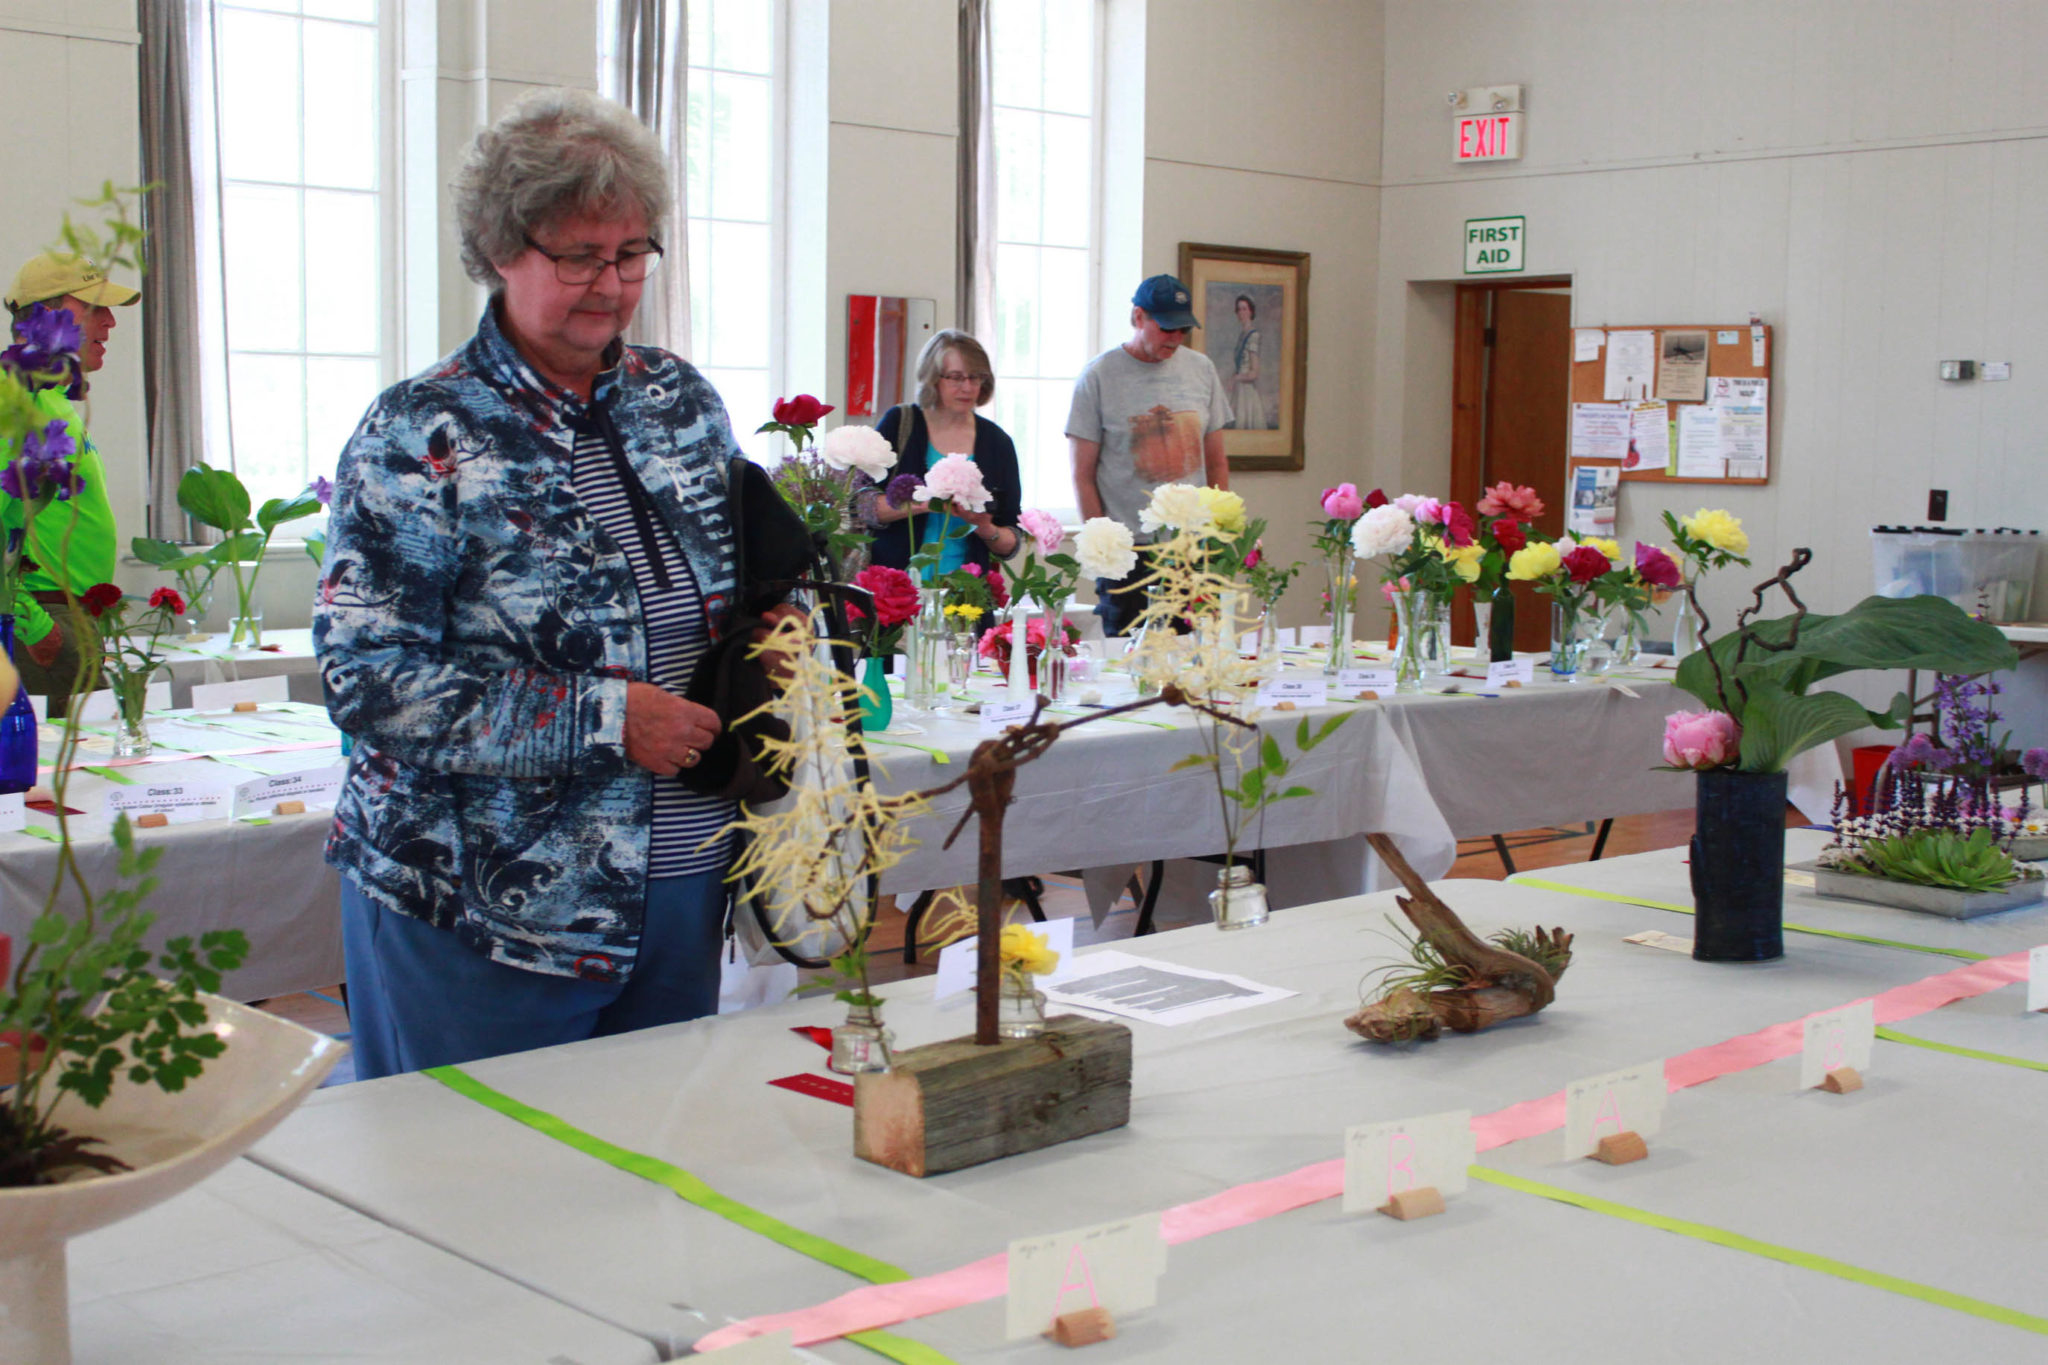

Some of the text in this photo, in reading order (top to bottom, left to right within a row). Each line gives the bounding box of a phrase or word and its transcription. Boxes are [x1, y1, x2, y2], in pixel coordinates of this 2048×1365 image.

[1459, 117, 1510, 158] EXIT
[1469, 226, 1520, 243] FIRST
[1476, 248, 1511, 264] AID
[1588, 1089, 1623, 1144] A
[1050, 1243, 1099, 1326] A
